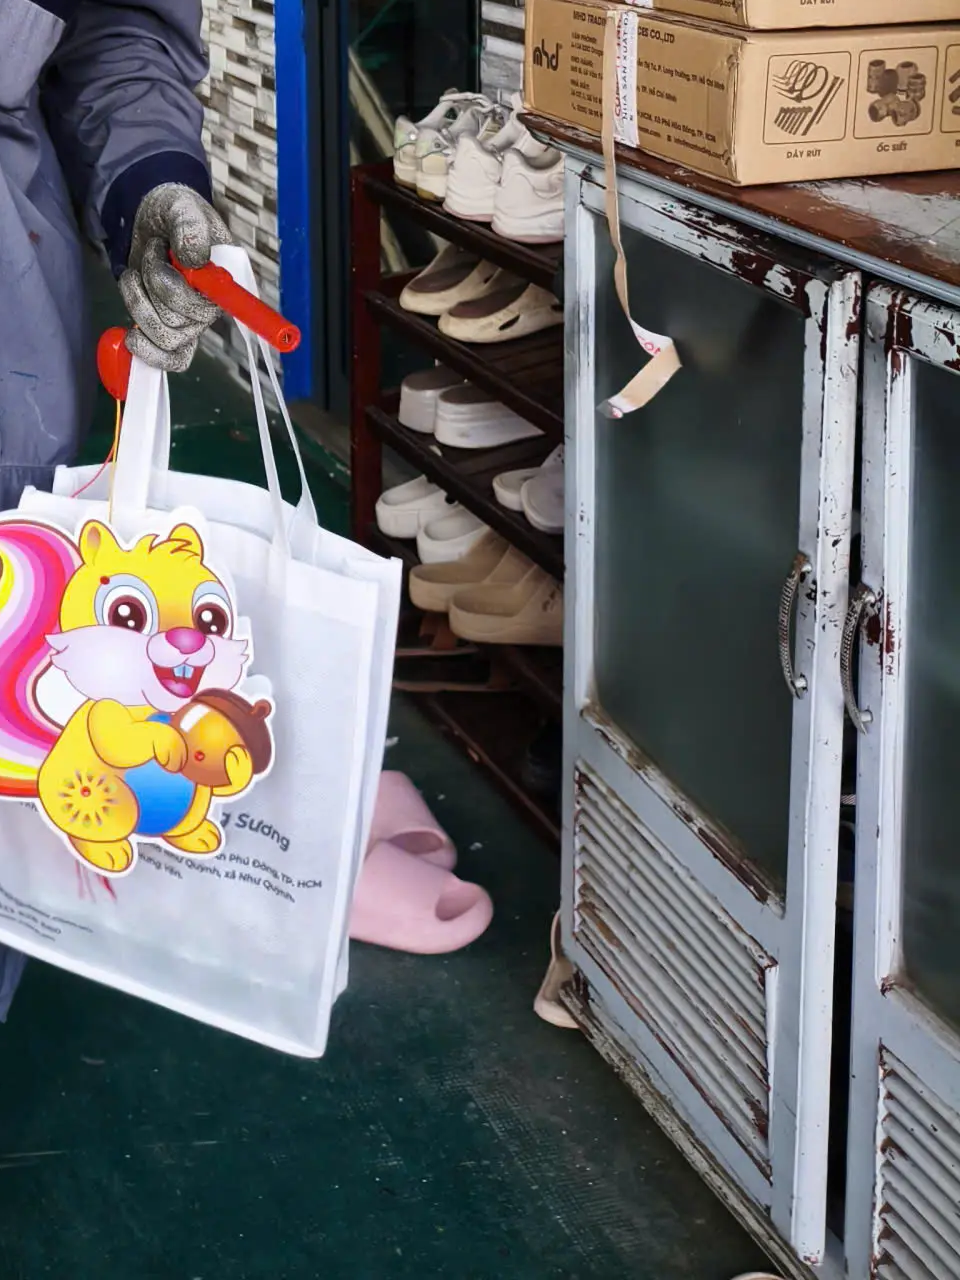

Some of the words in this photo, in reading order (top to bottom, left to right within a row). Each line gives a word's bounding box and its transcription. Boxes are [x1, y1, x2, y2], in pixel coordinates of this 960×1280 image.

[876, 141, 890, 153] ỐC
[786, 149, 803, 159] DÂY
[806, 148, 822, 158] RÚT
[235, 813, 291, 852] Sương
[238, 871, 262, 886] Như
[296, 880, 323, 889] HCM
